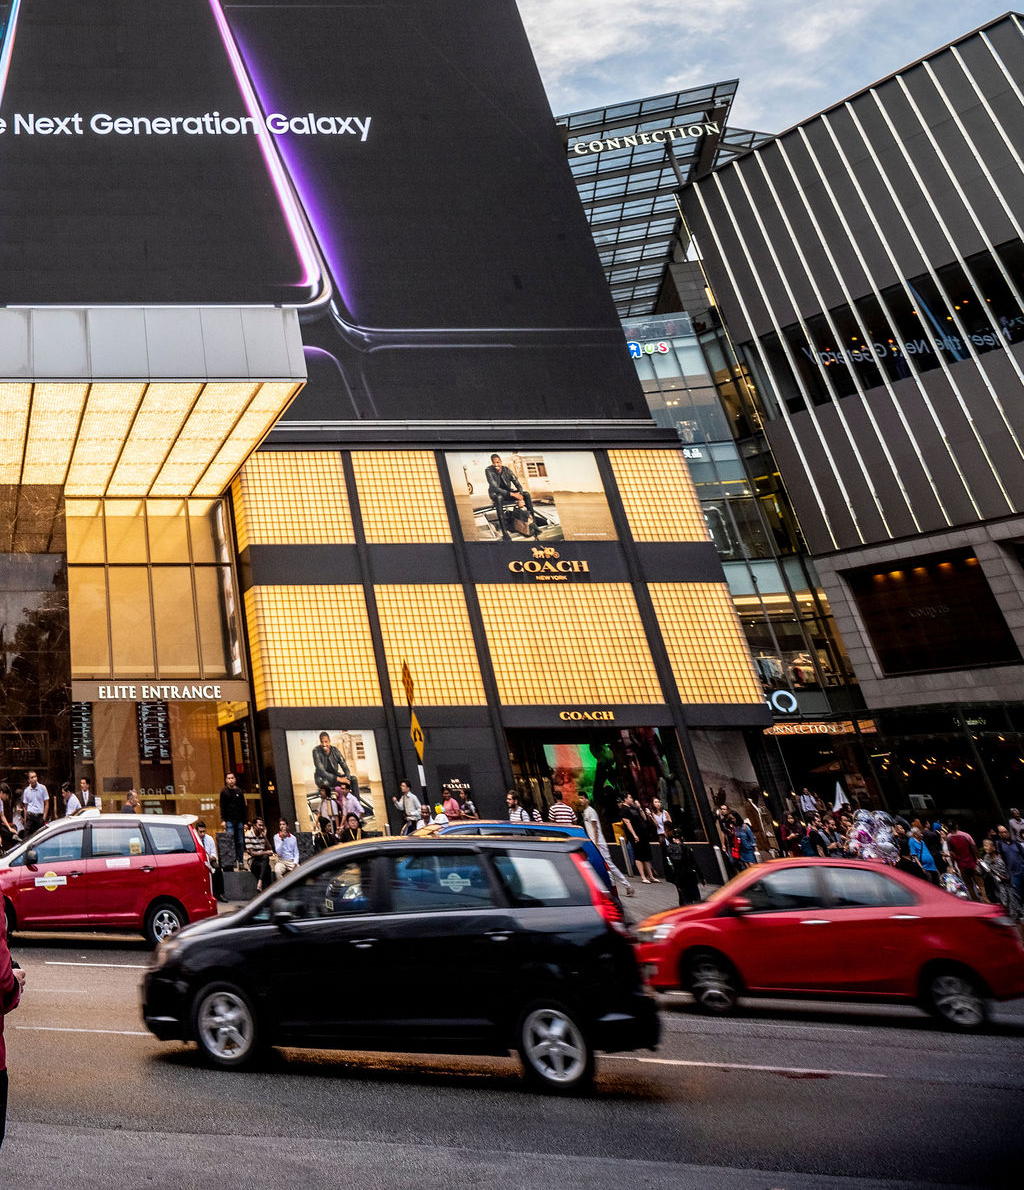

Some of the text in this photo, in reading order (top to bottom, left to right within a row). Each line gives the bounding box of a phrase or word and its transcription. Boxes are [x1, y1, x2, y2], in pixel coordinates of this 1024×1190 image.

[13, 112, 84, 135] Next
[90, 111, 261, 135] Generation
[266, 112, 372, 142] Galaxy
[574, 122, 721, 155] CONNECTION
[508, 560, 590, 573] COACH
[98, 685, 222, 699] ELITE ENTRANCE
[559, 711, 615, 721] COACH
